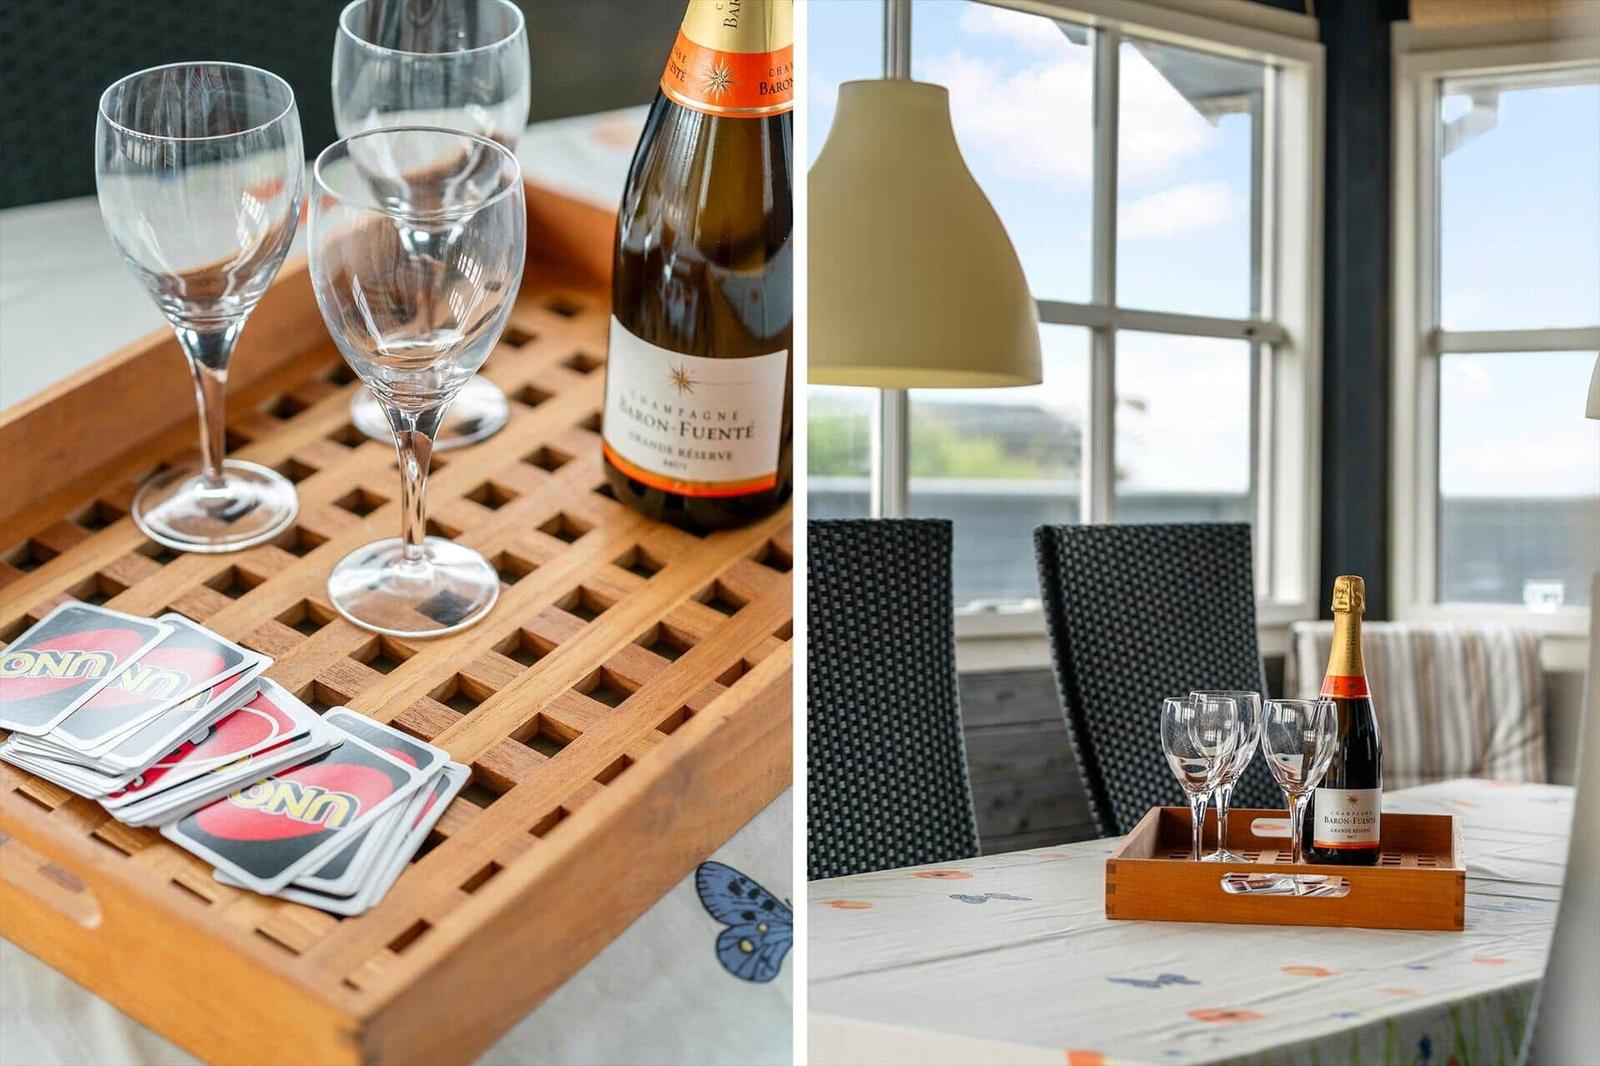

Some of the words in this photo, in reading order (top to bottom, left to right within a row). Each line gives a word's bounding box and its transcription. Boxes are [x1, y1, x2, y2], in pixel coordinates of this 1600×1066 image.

[629, 388, 739, 420] CHAMPAGNE
[627, 430, 673, 454] GRANDE
[678, 446, 733, 461] RÉSERVE
[0, 650, 117, 678] UNO
[116, 662, 192, 698] UN
[228, 777, 361, 829] UNO
